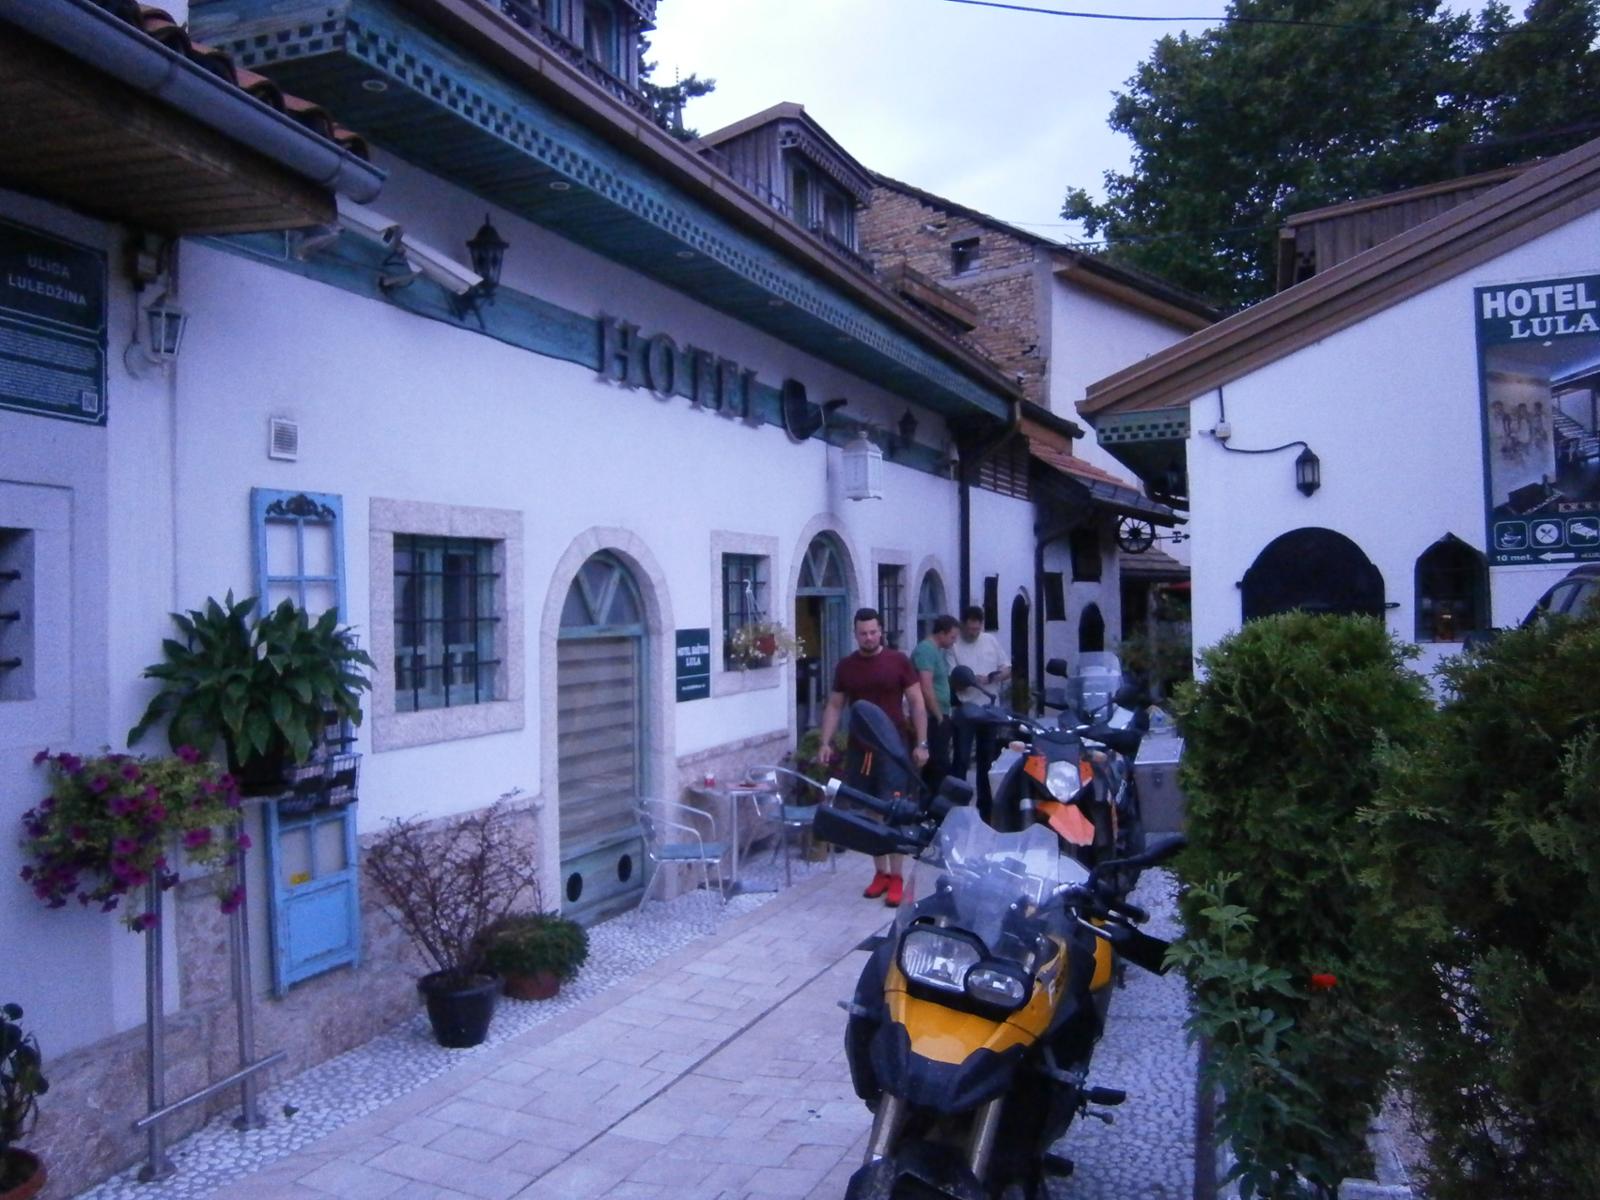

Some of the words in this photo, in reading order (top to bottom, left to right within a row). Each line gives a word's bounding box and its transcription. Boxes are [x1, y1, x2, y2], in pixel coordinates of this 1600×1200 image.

[1482, 283, 1597, 319] HOTEL
[1509, 312, 1600, 339] LULA
[595, 312, 765, 429] HOTEL
